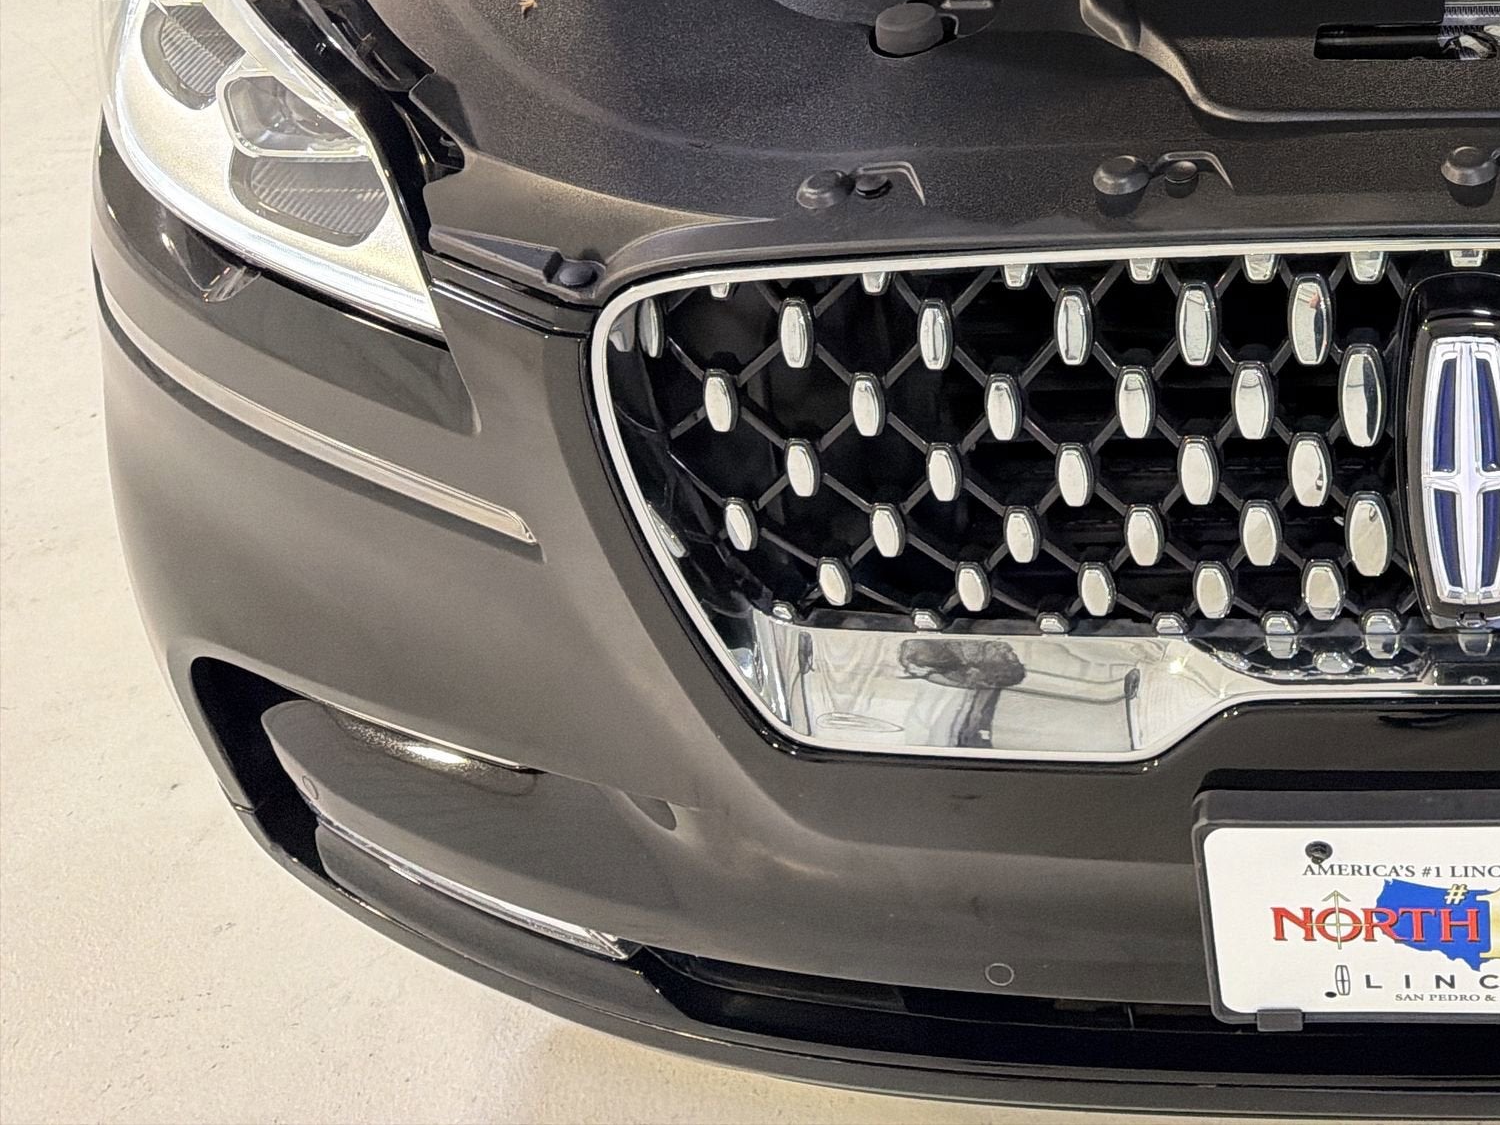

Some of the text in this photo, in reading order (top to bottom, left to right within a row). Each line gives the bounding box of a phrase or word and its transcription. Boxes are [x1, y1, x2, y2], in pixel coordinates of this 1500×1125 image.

[1302, 863, 1416, 878] AMERICA'S
[1421, 866, 1442, 878] #1
[1270, 906, 1480, 943] NORTH
[1395, 993, 1424, 1002] SAN
[1429, 993, 1481, 1002] PEDRO
[1485, 993, 1497, 1002] &
